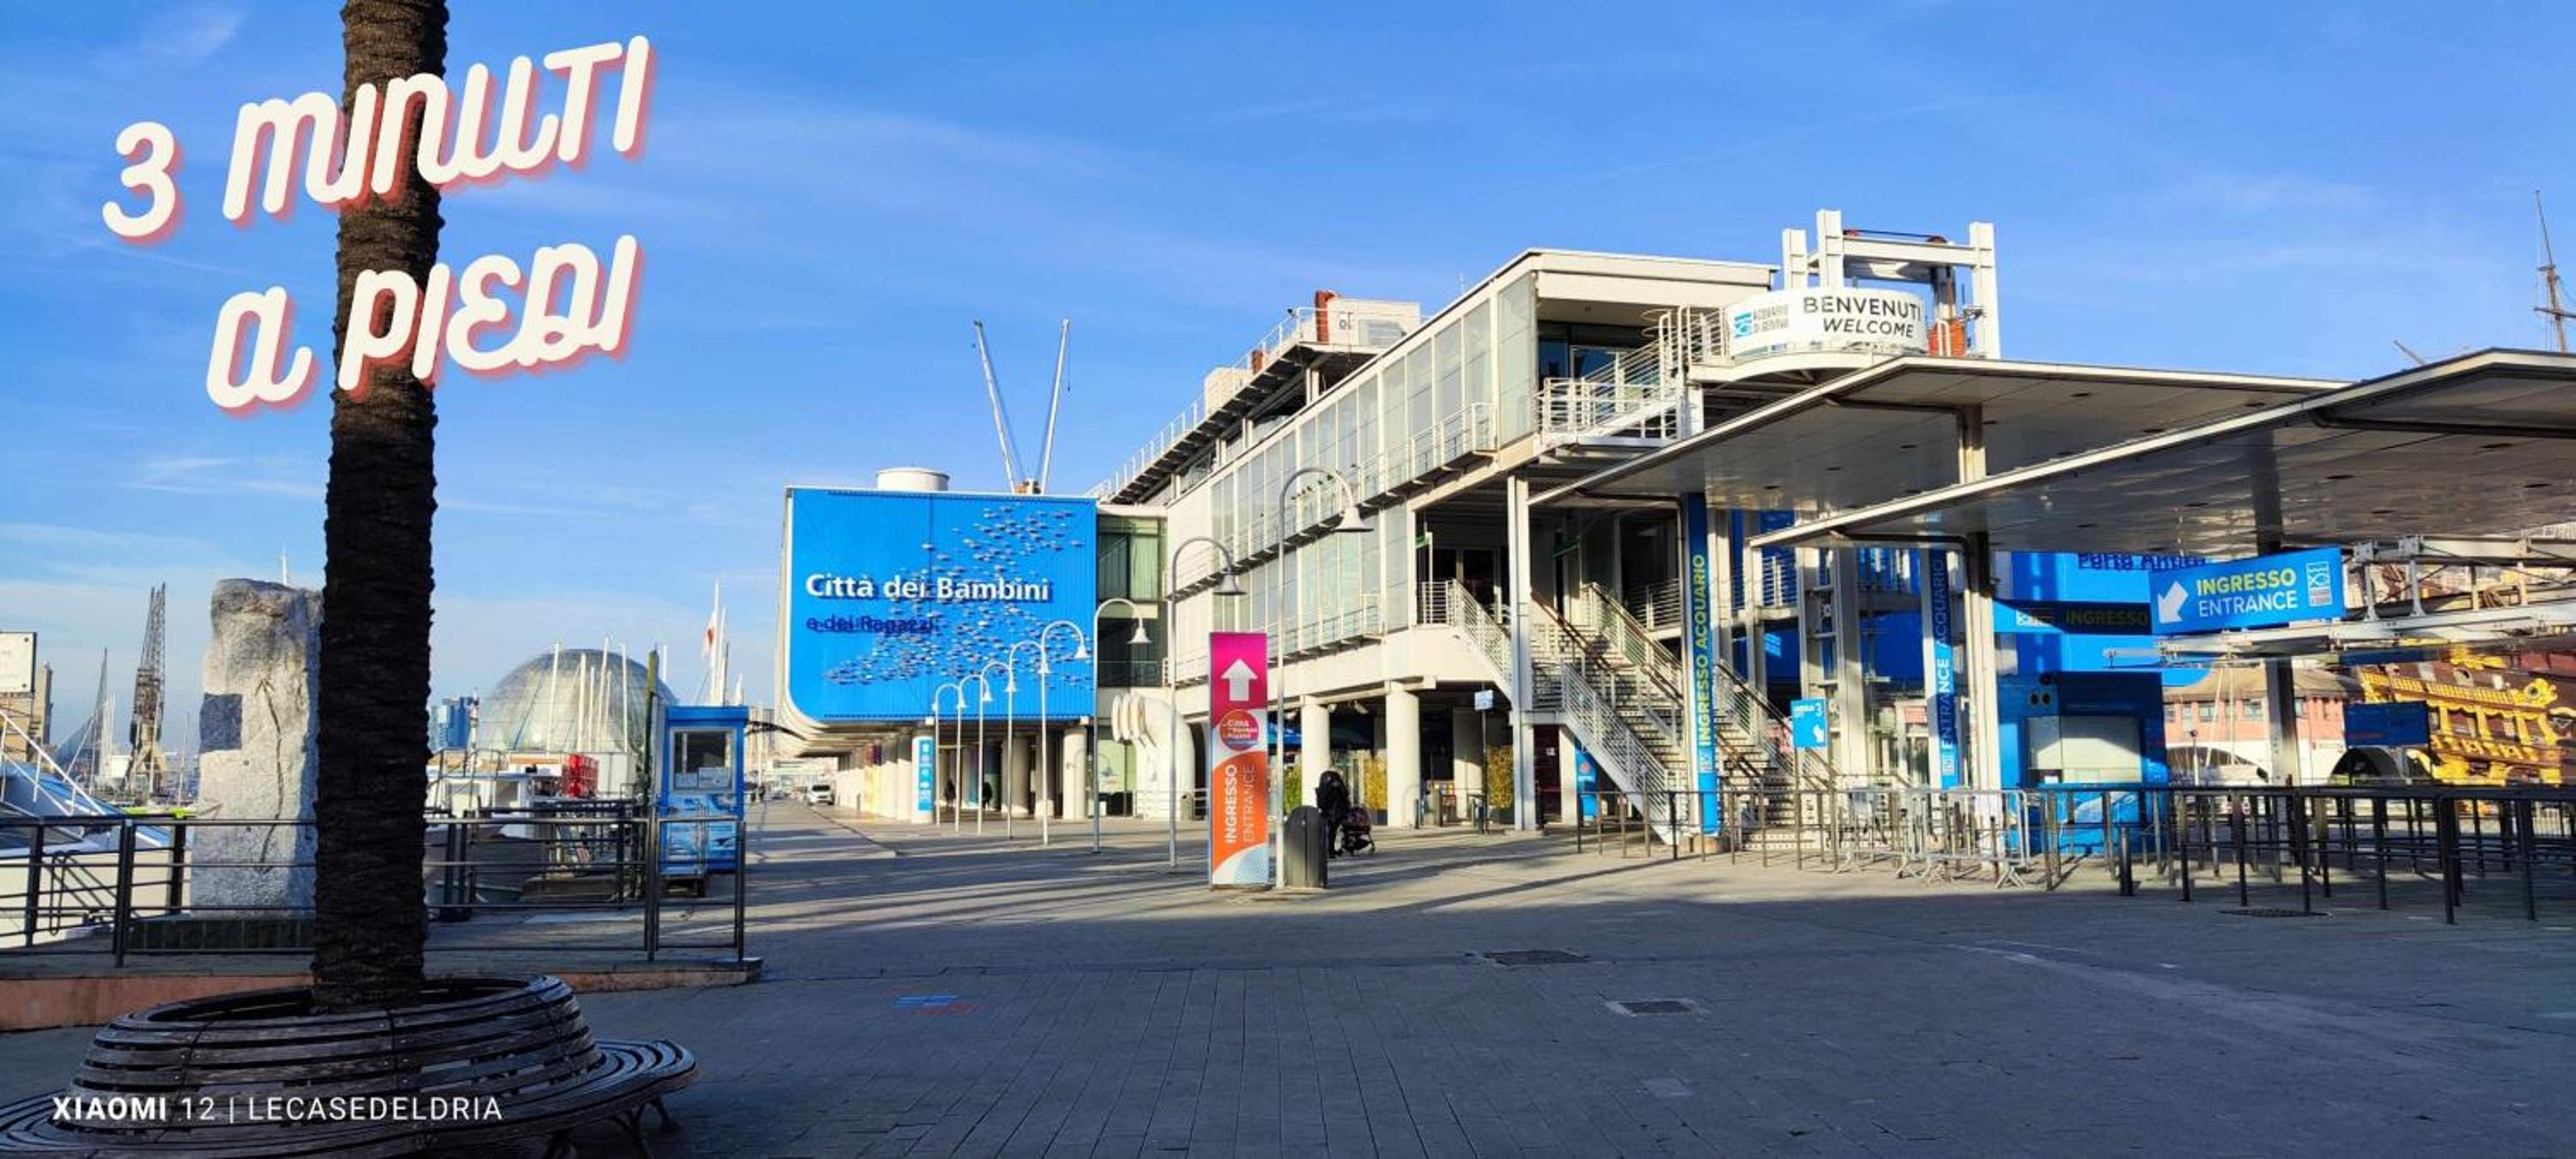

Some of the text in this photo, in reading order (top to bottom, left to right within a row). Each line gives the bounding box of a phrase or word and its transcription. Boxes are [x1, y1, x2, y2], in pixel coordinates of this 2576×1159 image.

[1803, 296, 1922, 322] BENVENUTI
[1822, 318, 1914, 339] WELCOME
[805, 573, 1048, 600] Città dei Bambini
[2196, 567, 2297, 596] INGRESSO
[2065, 610, 2148, 626] INGRESSO
[2198, 590, 2298, 618] ENTRANCE
[1692, 555, 1712, 747] INGRESSO ACQUARIO
[1932, 556, 1955, 750] ENTRANCE ACQUARIO
[1225, 764, 1237, 844] INGRESSO
[1242, 763, 1256, 843] ENTRANCE
